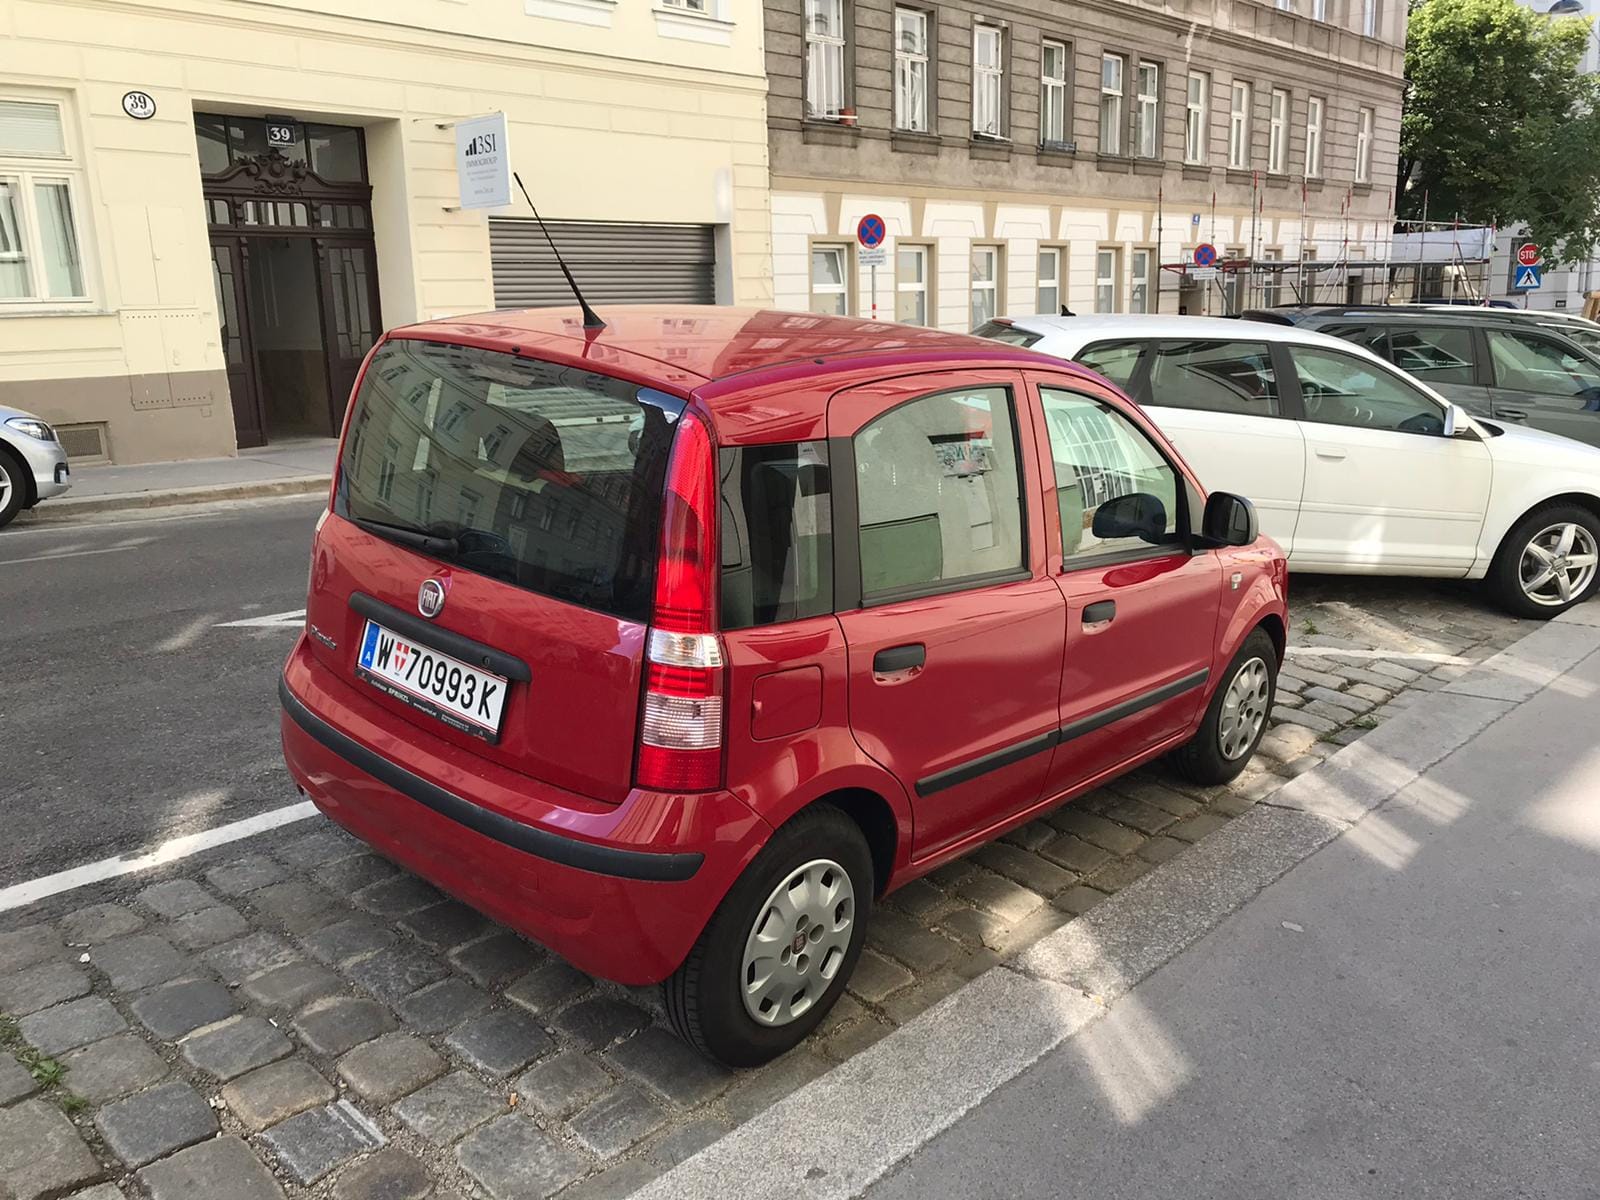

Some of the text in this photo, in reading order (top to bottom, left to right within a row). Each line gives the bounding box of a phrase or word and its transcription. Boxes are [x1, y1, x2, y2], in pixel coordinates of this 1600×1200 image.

[129, 94, 147, 109] 39
[270, 127, 291, 141] 39
[478, 133, 496, 154] 3SI
[1520, 250, 1536, 260] STO
[421, 590, 438, 609] FIAT
[377, 634, 395, 670] W
